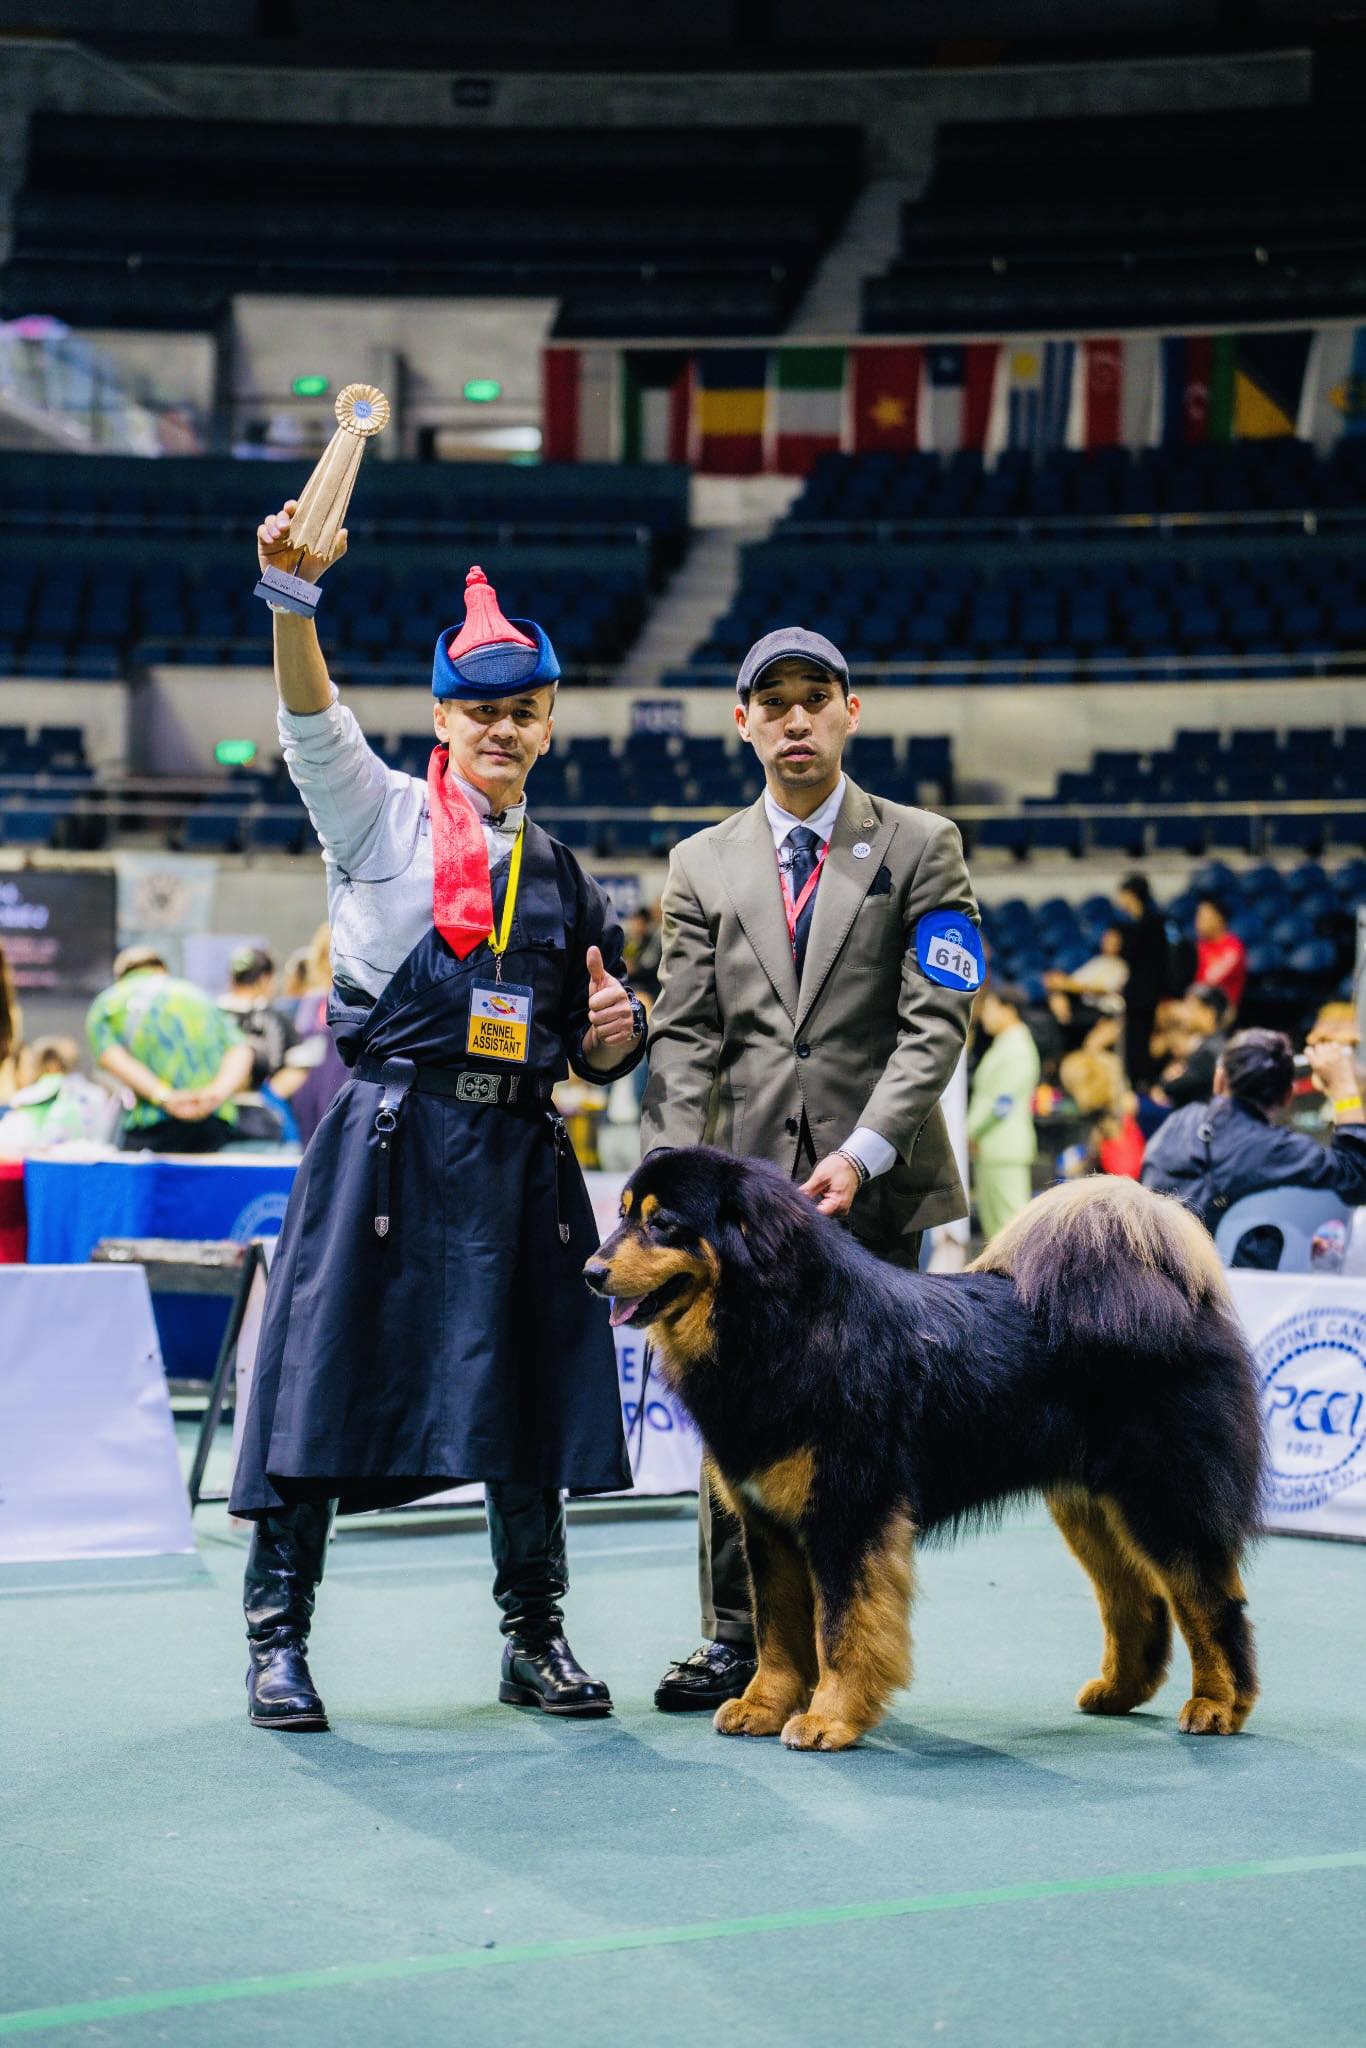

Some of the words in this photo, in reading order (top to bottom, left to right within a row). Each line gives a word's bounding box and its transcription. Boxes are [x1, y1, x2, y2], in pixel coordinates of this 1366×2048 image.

[936, 948, 972, 979] 618
[481, 1022, 516, 1040] KENNEL
[473, 1035, 521, 1054] ASSISTANT
[1267, 1385, 1364, 1438] PCCI
